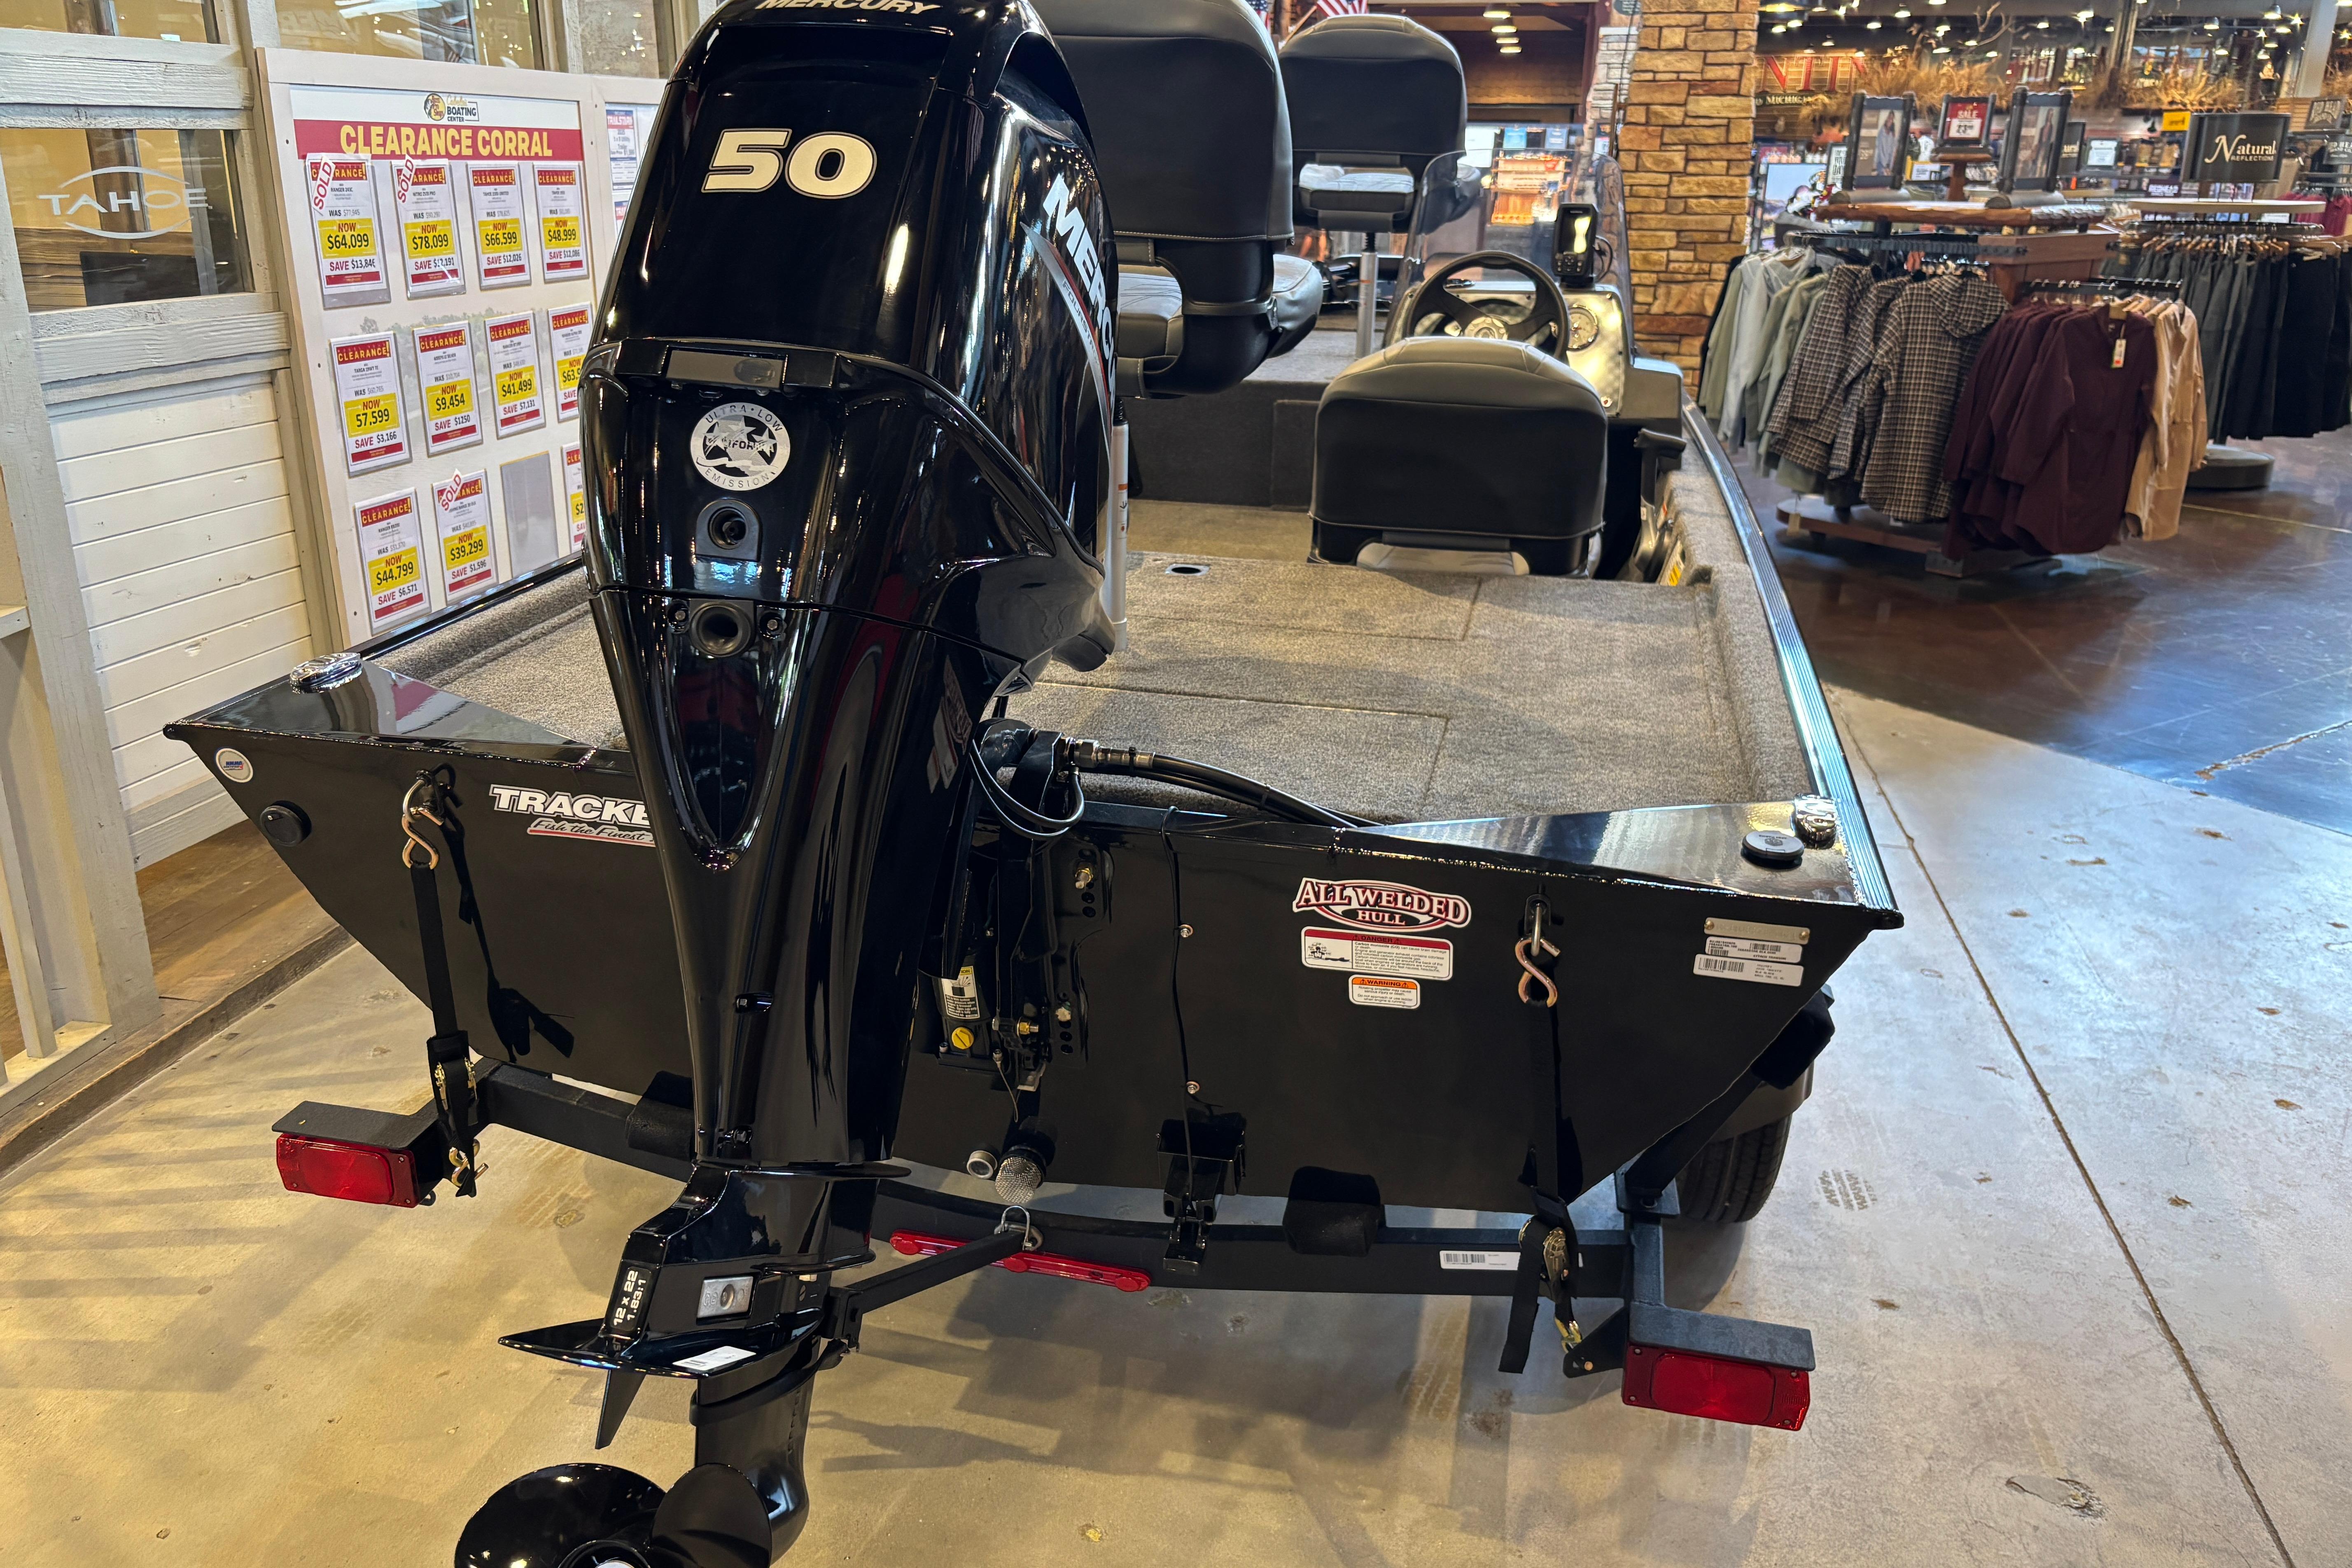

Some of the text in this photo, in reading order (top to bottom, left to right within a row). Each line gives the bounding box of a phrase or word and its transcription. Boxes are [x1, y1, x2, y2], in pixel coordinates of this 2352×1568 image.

[755, 0, 943, 14] MERCURY
[447, 106, 476, 116] BOATING
[341, 125, 552, 156] CLEARANCE CORRAL
[2205, 134, 2277, 163] Natural
[312, 163, 366, 180] CRANCE!
[701, 128, 877, 199] 50
[314, 161, 332, 210] SOLD
[397, 159, 414, 203] SOLD
[474, 170, 515, 184] CLEARANCE!
[538, 171, 575, 185] CLEARANCE!
[37, 188, 208, 215] TAHOE
[338, 223, 356, 233] NOW
[421, 224, 438, 234] NOW
[493, 222, 508, 231] NOW
[555, 219, 568, 228] NOW
[327, 233, 369, 250] $64,099
[412, 233, 449, 251] $78,099
[485, 231, 517, 247] $66,599
[548, 228, 576, 242] $48,999
[487, 253, 522, 266] SAVE $12,026
[549, 251, 562, 260] SAVE
[329, 260, 350, 272] SAVE
[415, 259, 432, 271] SAVE
[553, 310, 588, 328] CLEARANCE!
[490, 320, 530, 339] CLEARANCE!
[420, 330, 465, 350] CLEARANCE!
[338, 341, 390, 362] CLEARANCE!
[569, 359, 581, 367] NOW
[509, 371, 523, 381] NOW
[562, 369, 581, 383] $63,9
[441, 384, 457, 396] NOW
[502, 378, 533, 397] $41,499
[564, 390, 576, 400] SAVE
[363, 399, 380, 411] NOW
[436, 393, 465, 411] $9,454
[503, 399, 535, 415] SAVE $7,131
[435, 414, 471, 431] SAVE $1250
[706, 404, 783, 432] ULTRA LOW
[355, 431, 397, 449] SAVE $3,166
[705, 468, 770, 488] EMISSION
[441, 474, 462, 511] SOLD
[362, 498, 411, 523] CLEARANCE!
[452, 524, 462, 532] WAS
[458, 532, 473, 544] NOW
[450, 539, 483, 561] $39,299
[385, 554, 402, 568] NOW
[376, 561, 413, 586] $44,799
[452, 560, 486, 580] SAVE $1,596
[378, 585, 418, 605] SAVE $6,571
[489, 784, 651, 828] TRACKE
[533, 819, 648, 841] Fish the Finest
[1297, 880, 1468, 924] ALL WELDED
[1356, 909, 1406, 926] HULL
[614, 1270, 638, 1325] 12 x 22
[627, 1279, 646, 1321] 1.83:1
